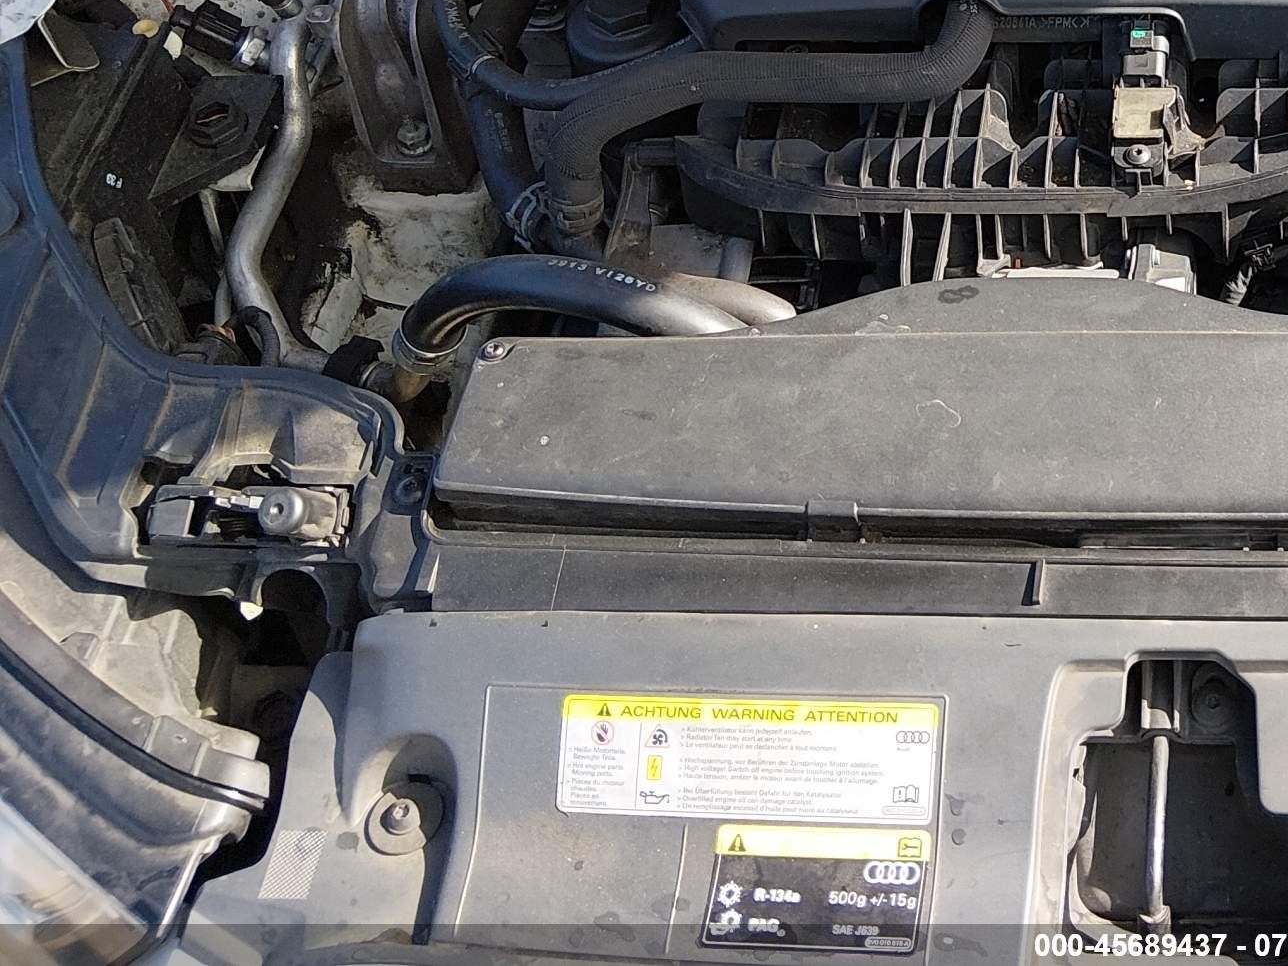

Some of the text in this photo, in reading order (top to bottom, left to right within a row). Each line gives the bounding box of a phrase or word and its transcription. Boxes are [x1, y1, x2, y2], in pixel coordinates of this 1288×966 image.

[620, 705, 898, 723] ACHTUNG WARNING ATTENTION
[753, 887, 801, 903] R-134a
[828, 890, 866, 908] 500g
[747, 917, 780, 934] PAG
[832, 924, 880, 936] SAE J639
